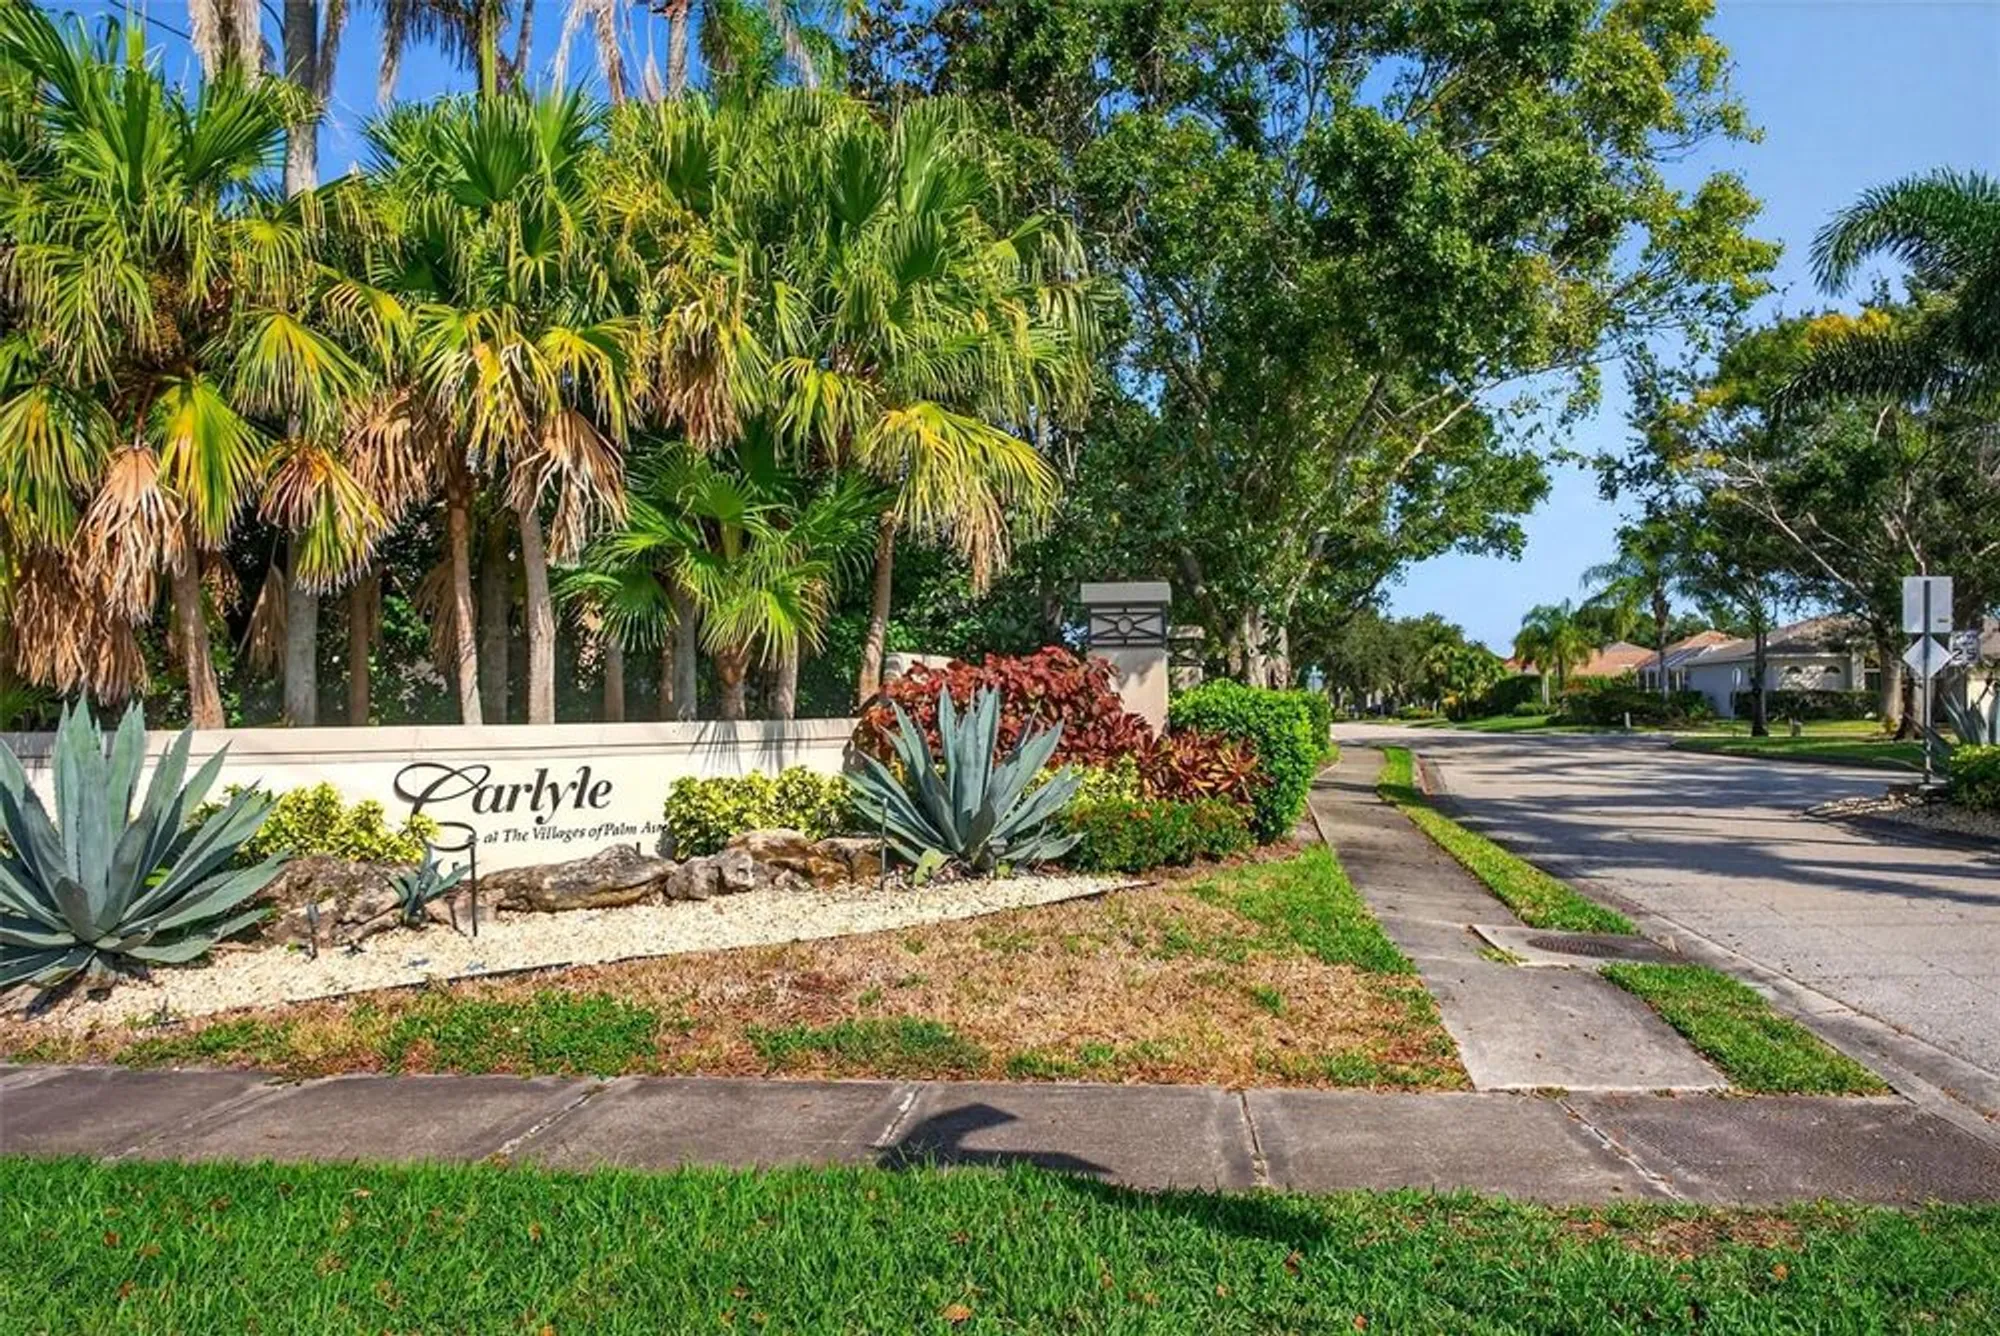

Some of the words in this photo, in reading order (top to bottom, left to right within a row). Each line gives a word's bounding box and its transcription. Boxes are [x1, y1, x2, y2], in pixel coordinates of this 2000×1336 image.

[1952, 648, 1977, 660] 25
[393, 762, 613, 851] Carlyle
[483, 830, 499, 843] at
[503, 828, 529, 843] The
[532, 826, 587, 843] Villages
[588, 823, 604, 841] of
[604, 822, 637, 836] Palm
